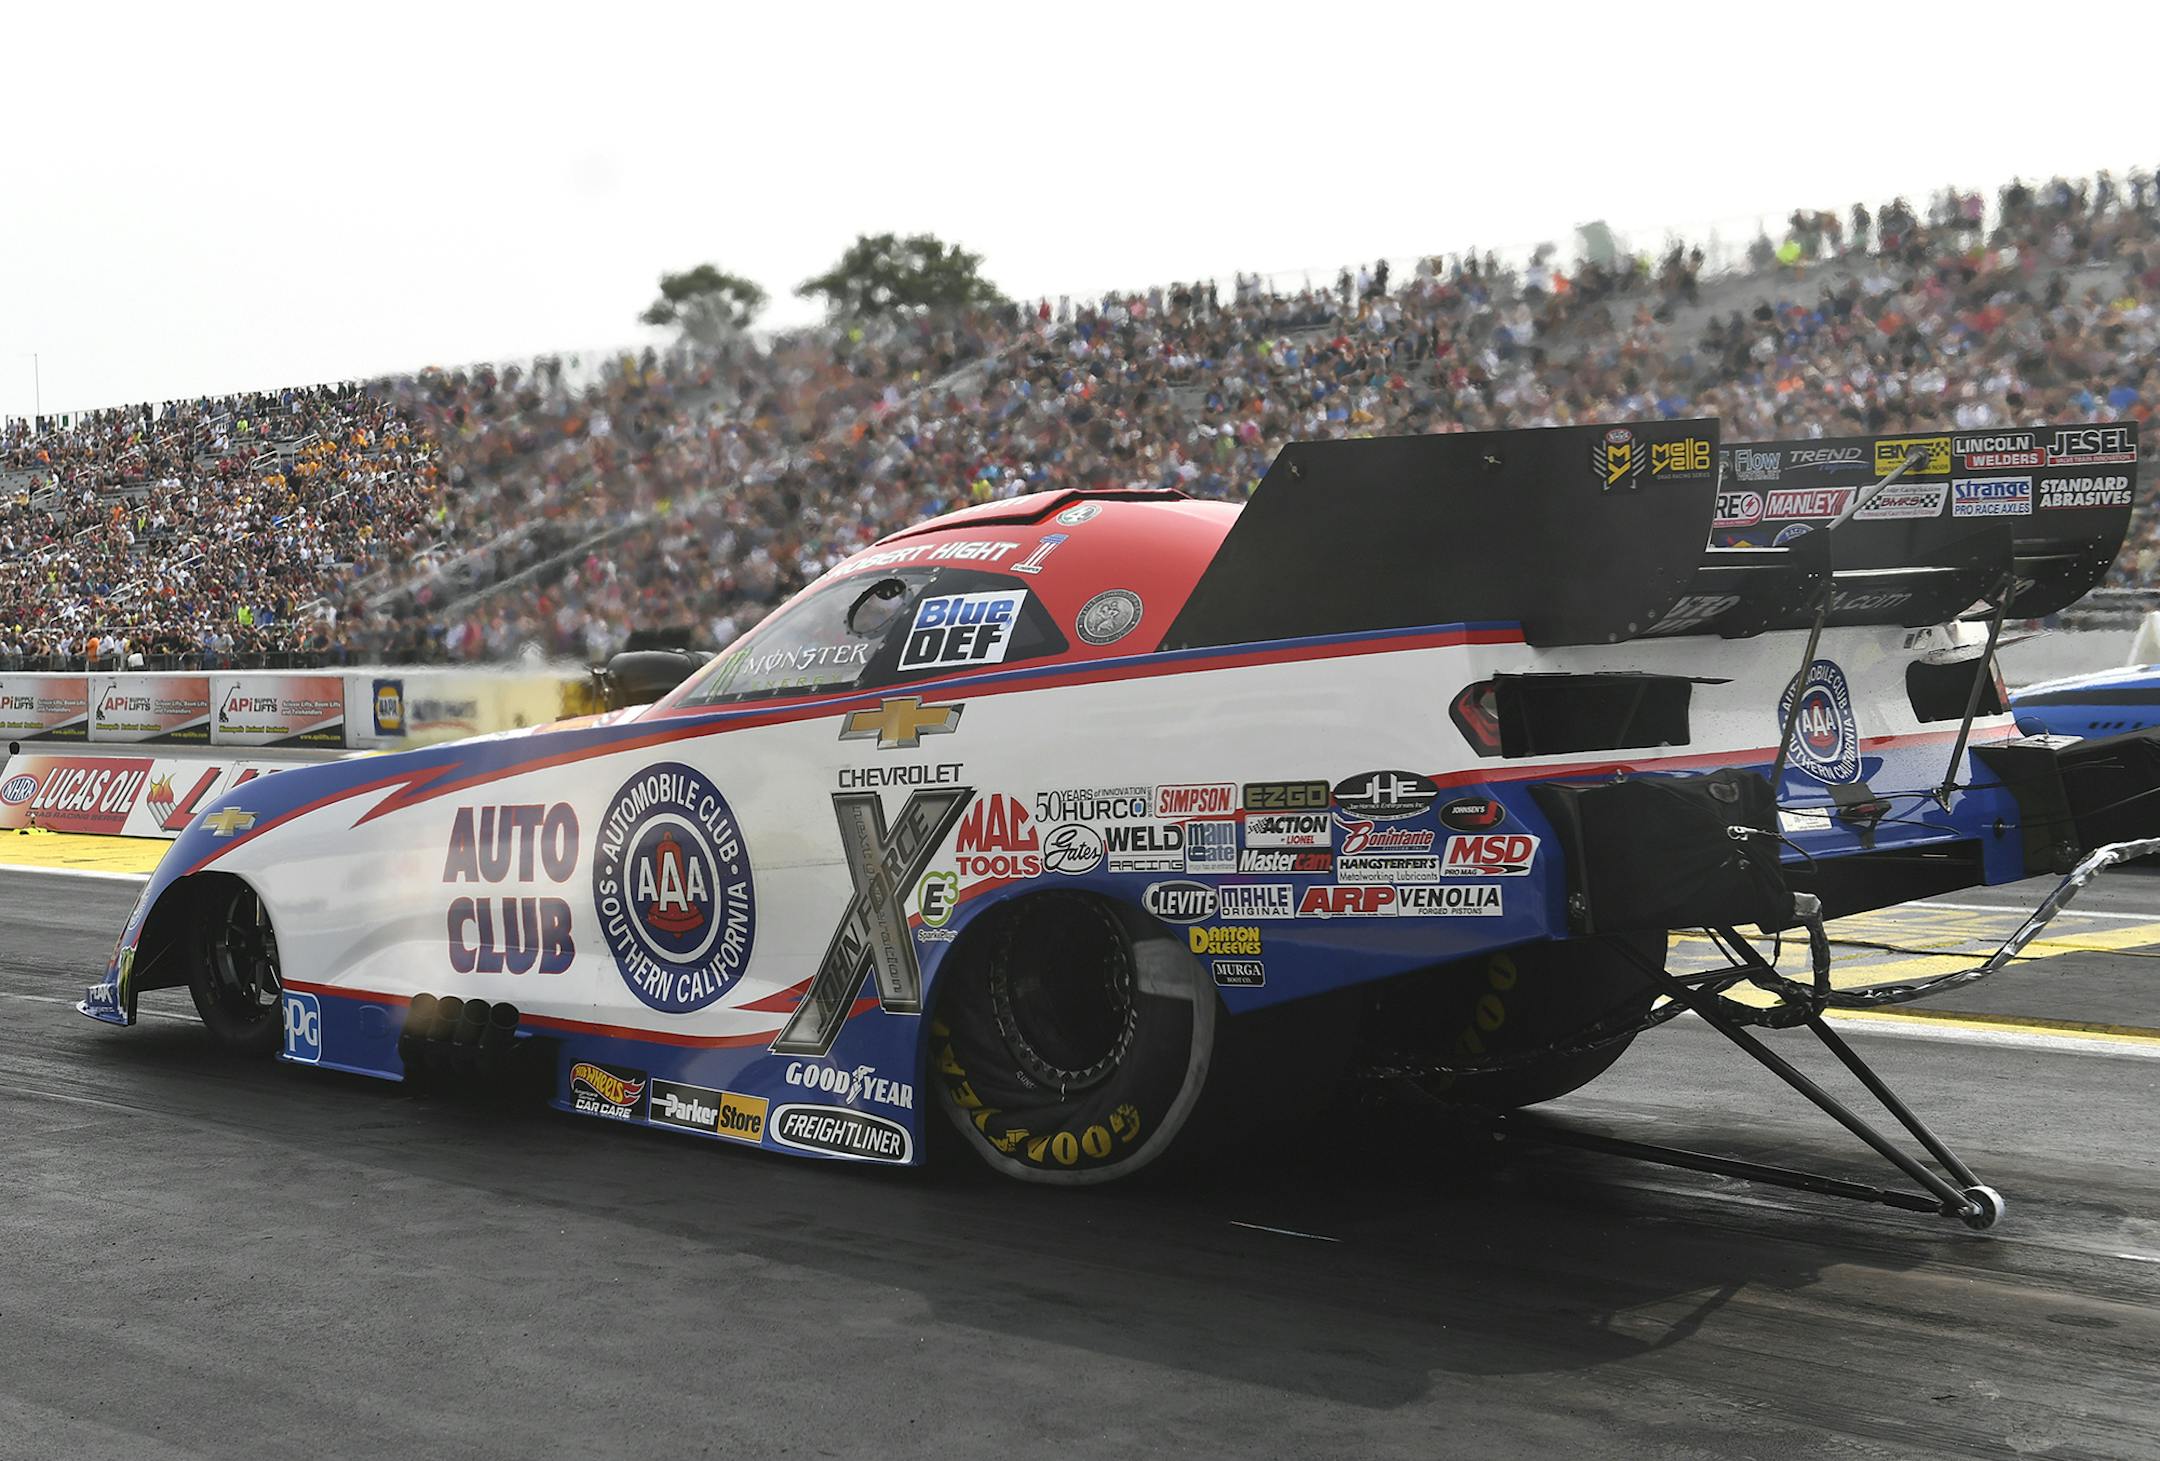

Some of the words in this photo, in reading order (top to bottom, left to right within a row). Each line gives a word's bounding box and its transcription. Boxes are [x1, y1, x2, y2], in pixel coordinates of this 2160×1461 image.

[1956, 436, 2030, 453] LINCOLN
[2048, 429, 2135, 456] JESEL
[1734, 449, 1781, 471] Flow
[1790, 447, 1862, 463] TREND
[1973, 453, 2039, 466] WELDERS
[2040, 477, 2128, 493] STANDARD
[1768, 492, 1841, 515] MANLEY
[1955, 505, 1973, 515] PRO
[1975, 504, 1999, 514] RACE
[2001, 503, 2030, 513] AXLES
[2040, 491, 2131, 507] ABRASIVES
[927, 541, 1021, 561] HIGHT
[915, 599, 1015, 629] Blue
[903, 626, 1007, 666] DEF
[129, 703, 150, 711] LIFTS
[254, 704, 277, 712] LIFTS
[1802, 706, 1836, 737] AAA
[838, 763, 964, 788] CHEVROLET
[3, 778, 36, 801] NHRA
[31, 768, 111, 811] LUCAS
[100, 770, 145, 813] OIL
[1159, 787, 1231, 813] SIMPSON
[1246, 785, 1326, 807] EZGO
[1334, 774, 1437, 804] JHE
[1035, 791, 1061, 822] 50
[1060, 789, 1093, 801] YEARS
[1101, 786, 1146, 796] INNOVATION
[1062, 798, 1147, 821] HURCO
[602, 773, 700, 863] AUTOMOBILE
[699, 796, 739, 863] CLUB
[956, 793, 1039, 853] MAC
[1259, 816, 1328, 833] ACTION
[443, 802, 580, 883] AUTO
[1105, 825, 1184, 852] WELD
[1287, 836, 1314, 844] LIONEL
[1336, 816, 1435, 852] Boninfante
[1049, 828, 1101, 868] Gates
[1448, 836, 1533, 865] MSD
[956, 856, 1041, 877] TOOLS
[1109, 860, 1183, 871] RACING
[1340, 858, 1437, 869] HANGSTERFER'S
[638, 852, 708, 912] AAA
[1339, 871, 1393, 882] Metalworking
[1397, 871, 1438, 881] Lubricants
[1146, 884, 1215, 915] CLEVITE
[1221, 887, 1288, 907] MAHLE
[1300, 887, 1396, 912] ARP
[1400, 887, 1500, 907] VENOLIA
[1222, 908, 1289, 916] ORIGINAL
[447, 897, 577, 976] CLUB
[600, 880, 674, 1002] SOUTHERN
[677, 881, 749, 1003] CALIFORNIA
[1189, 926, 1260, 953] DARTON
[1208, 942, 1262, 954] SLEEVES
[815, 922, 862, 1034] JOHN
[1216, 964, 1261, 976] MURGA
[575, 1099, 600, 1112] CAR
[600, 1104, 632, 1118] CARE
[666, 1093, 719, 1127] Parker
[721, 1104, 761, 1133] Store
[783, 1114, 900, 1155] FREIGHTLINER
